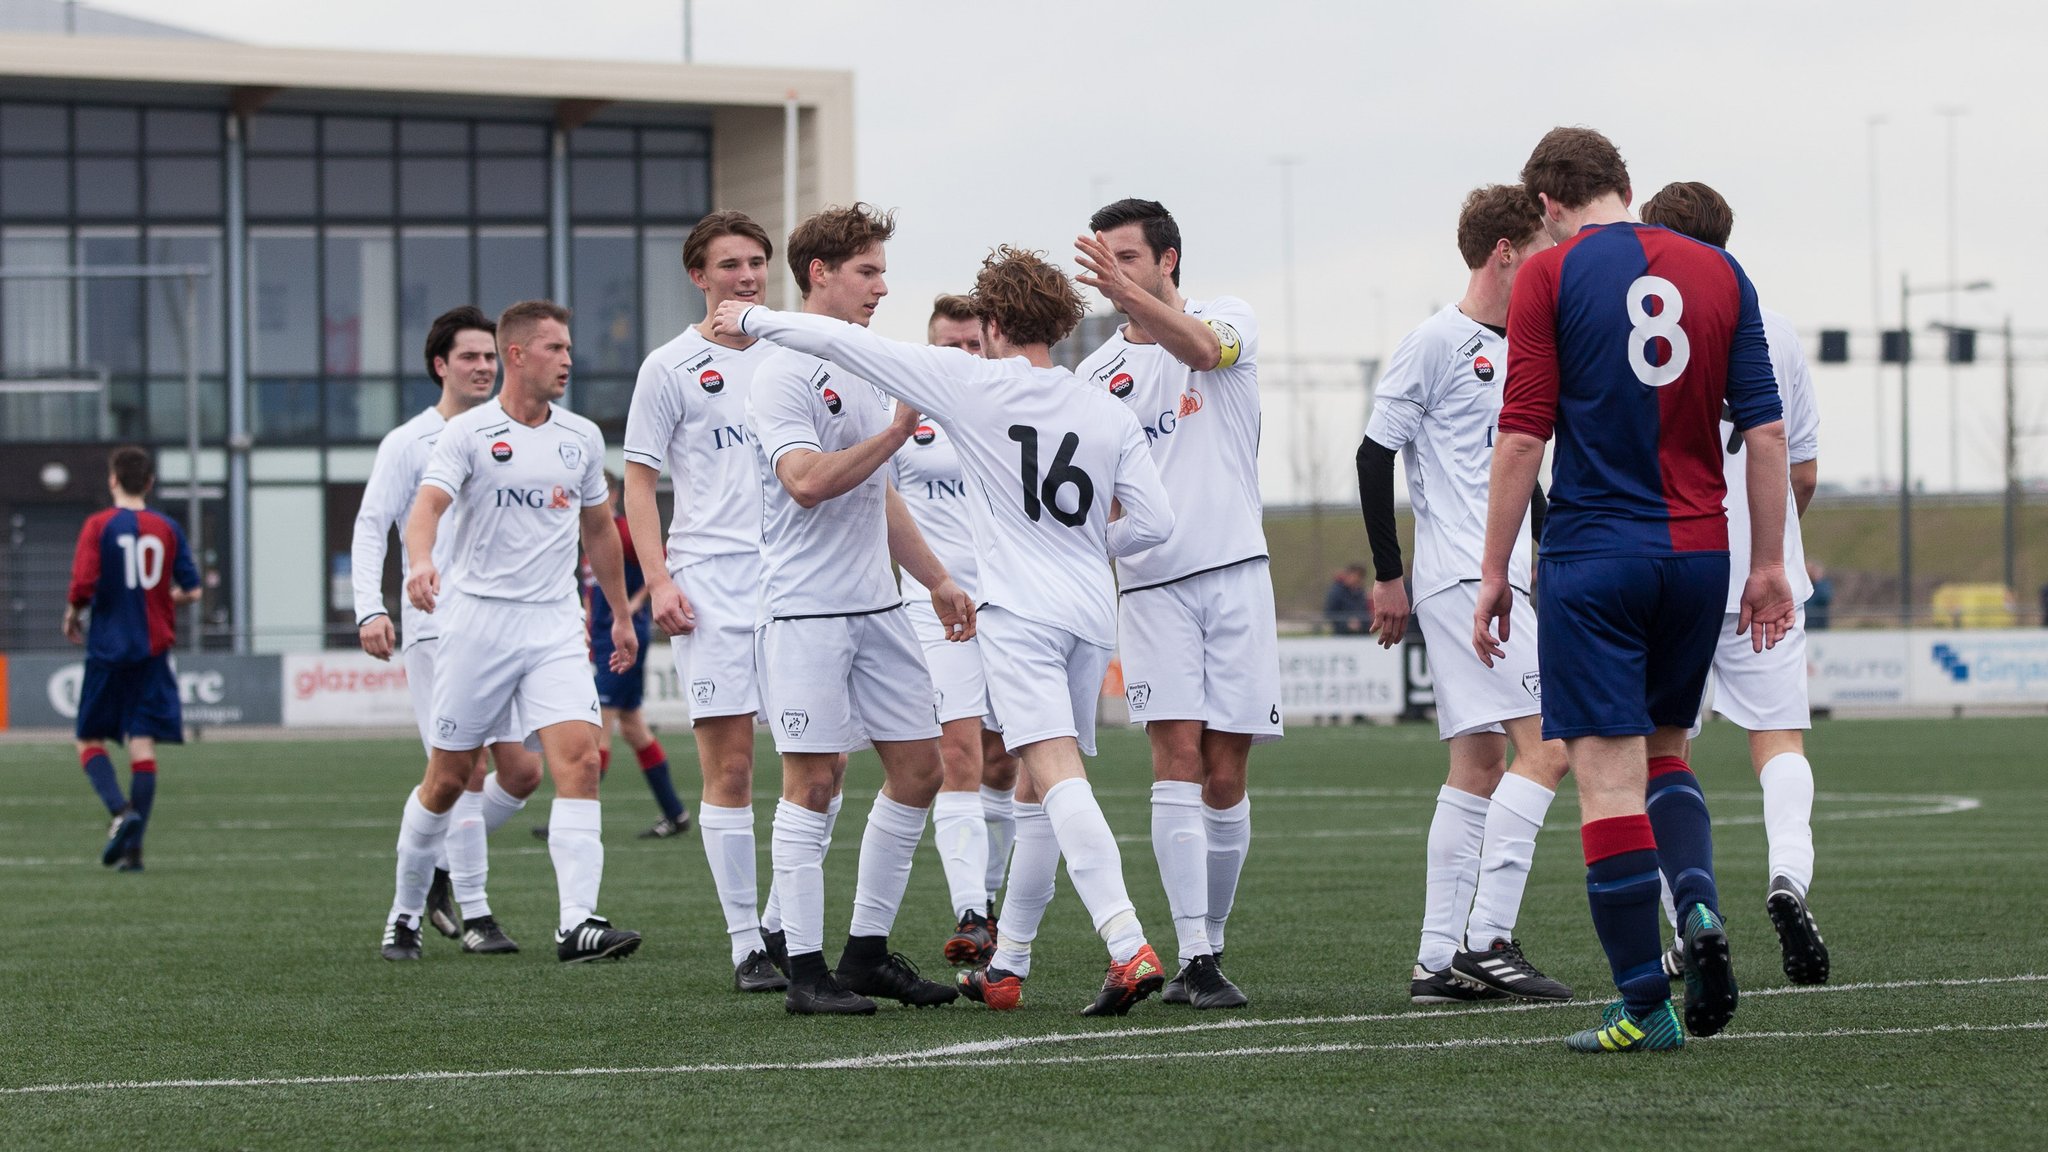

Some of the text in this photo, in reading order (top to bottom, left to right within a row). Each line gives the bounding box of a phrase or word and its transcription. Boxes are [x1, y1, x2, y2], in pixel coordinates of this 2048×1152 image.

[1626, 275, 1691, 387] 8
[1463, 338, 1484, 359] hummel
[686, 354, 714, 374] hummel
[1098, 357, 1127, 382] hummel
[701, 374, 721, 384] SPORT
[704, 380, 721, 388] 2000
[1111, 376, 1131, 390] SPORT
[1114, 382, 1130, 393] 2000
[712, 424, 750, 451] IN
[1008, 424, 1094, 528] 16
[495, 488, 544, 509] ING
[116, 533, 165, 591] 10
[1270, 703, 1280, 725] 6
[1134, 966, 1157, 980] adidas
